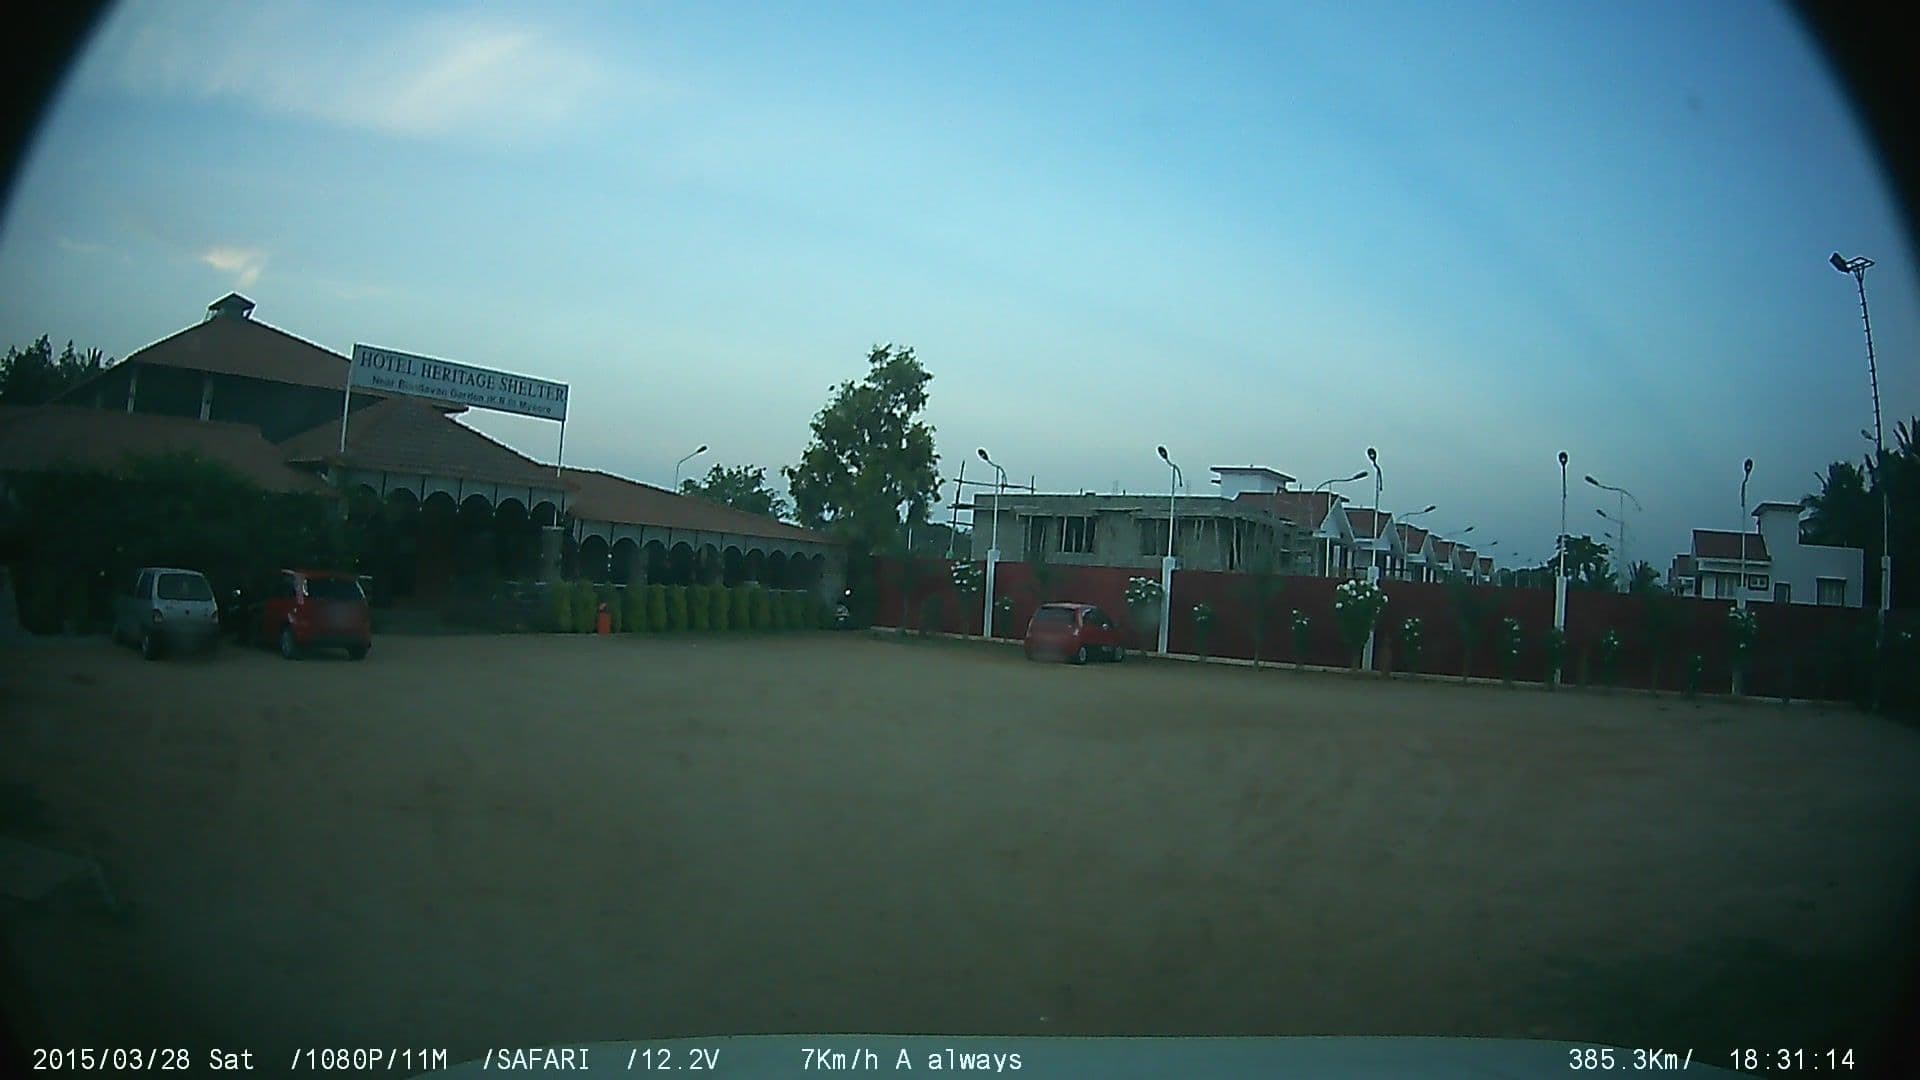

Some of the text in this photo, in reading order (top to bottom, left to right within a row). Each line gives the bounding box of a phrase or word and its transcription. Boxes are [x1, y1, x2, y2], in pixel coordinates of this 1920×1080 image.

[360, 350, 417, 376] HOTEL
[421, 362, 495, 390] HERITAGE
[499, 377, 565, 403] SHELTER
